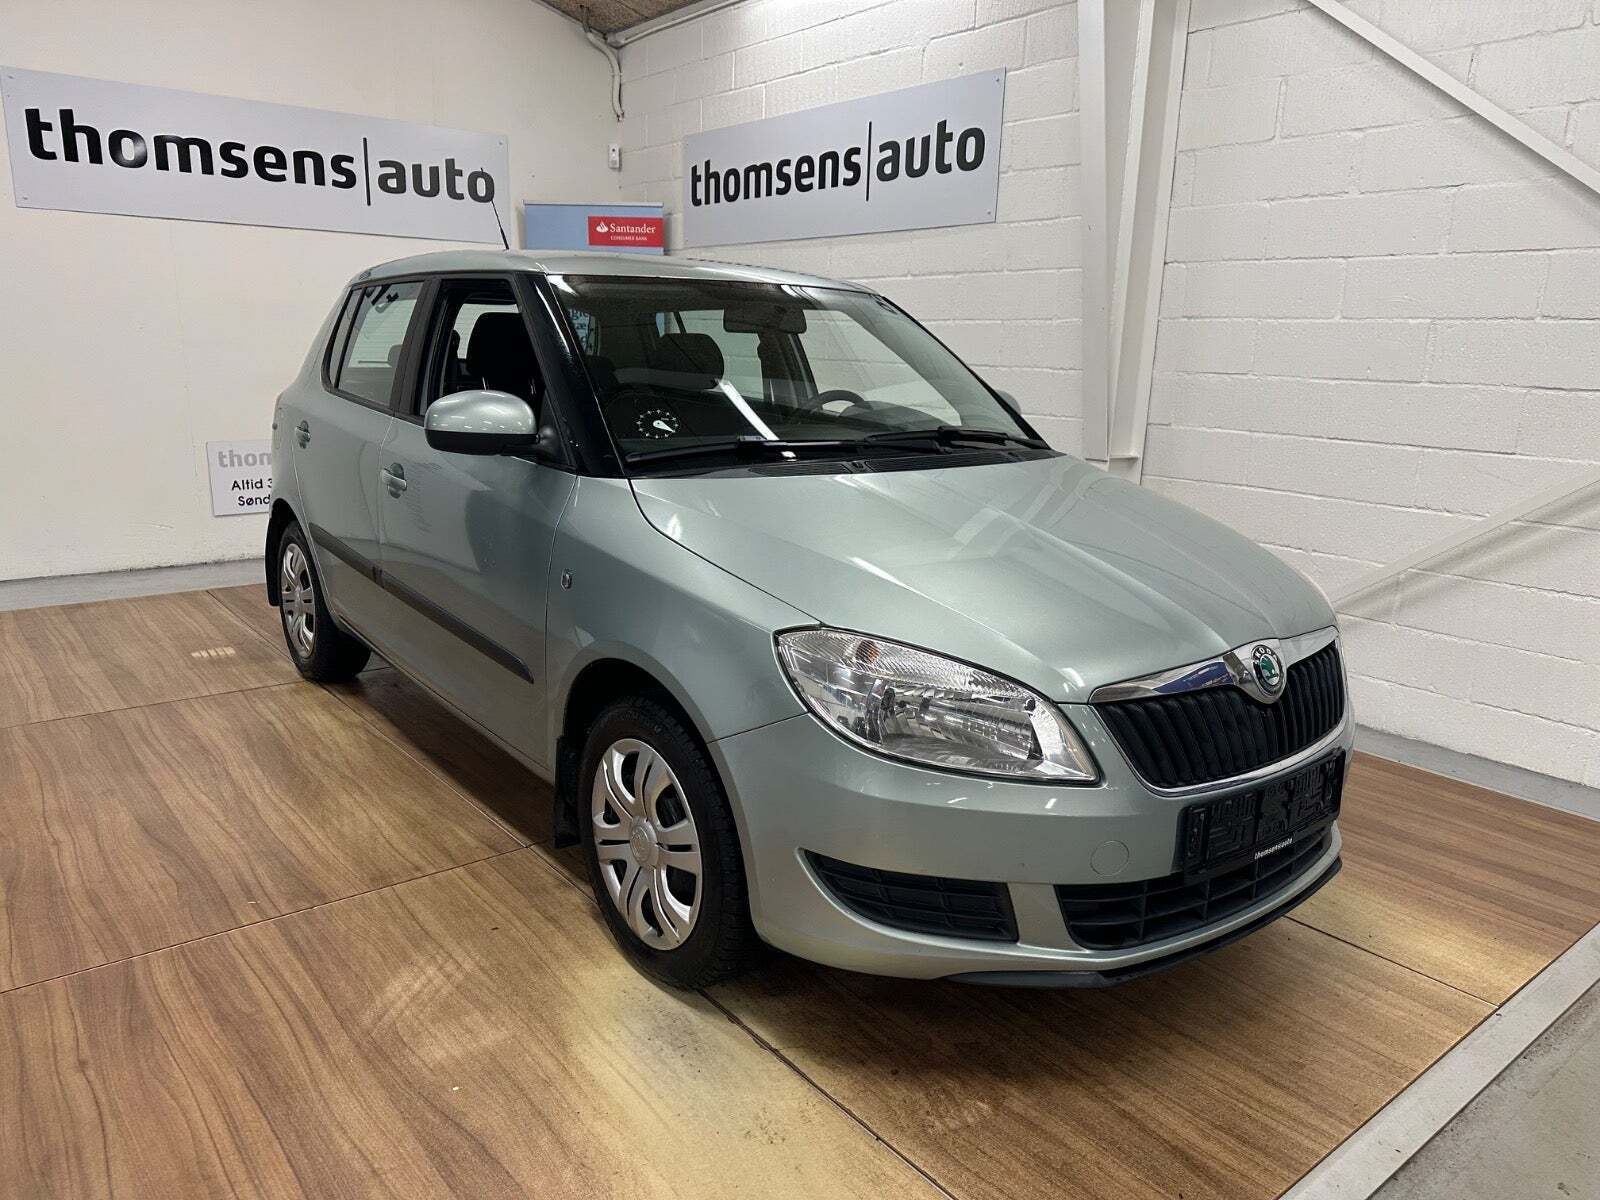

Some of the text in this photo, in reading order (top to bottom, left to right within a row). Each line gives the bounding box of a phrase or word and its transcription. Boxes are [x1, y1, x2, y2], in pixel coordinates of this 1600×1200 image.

[25, 107, 495, 204] thomsens auto
[691, 119, 986, 207] thomsens auto
[610, 223, 656, 234] Santander
[231, 478, 263, 491] Altid
[238, 494, 271, 506] Sønd
